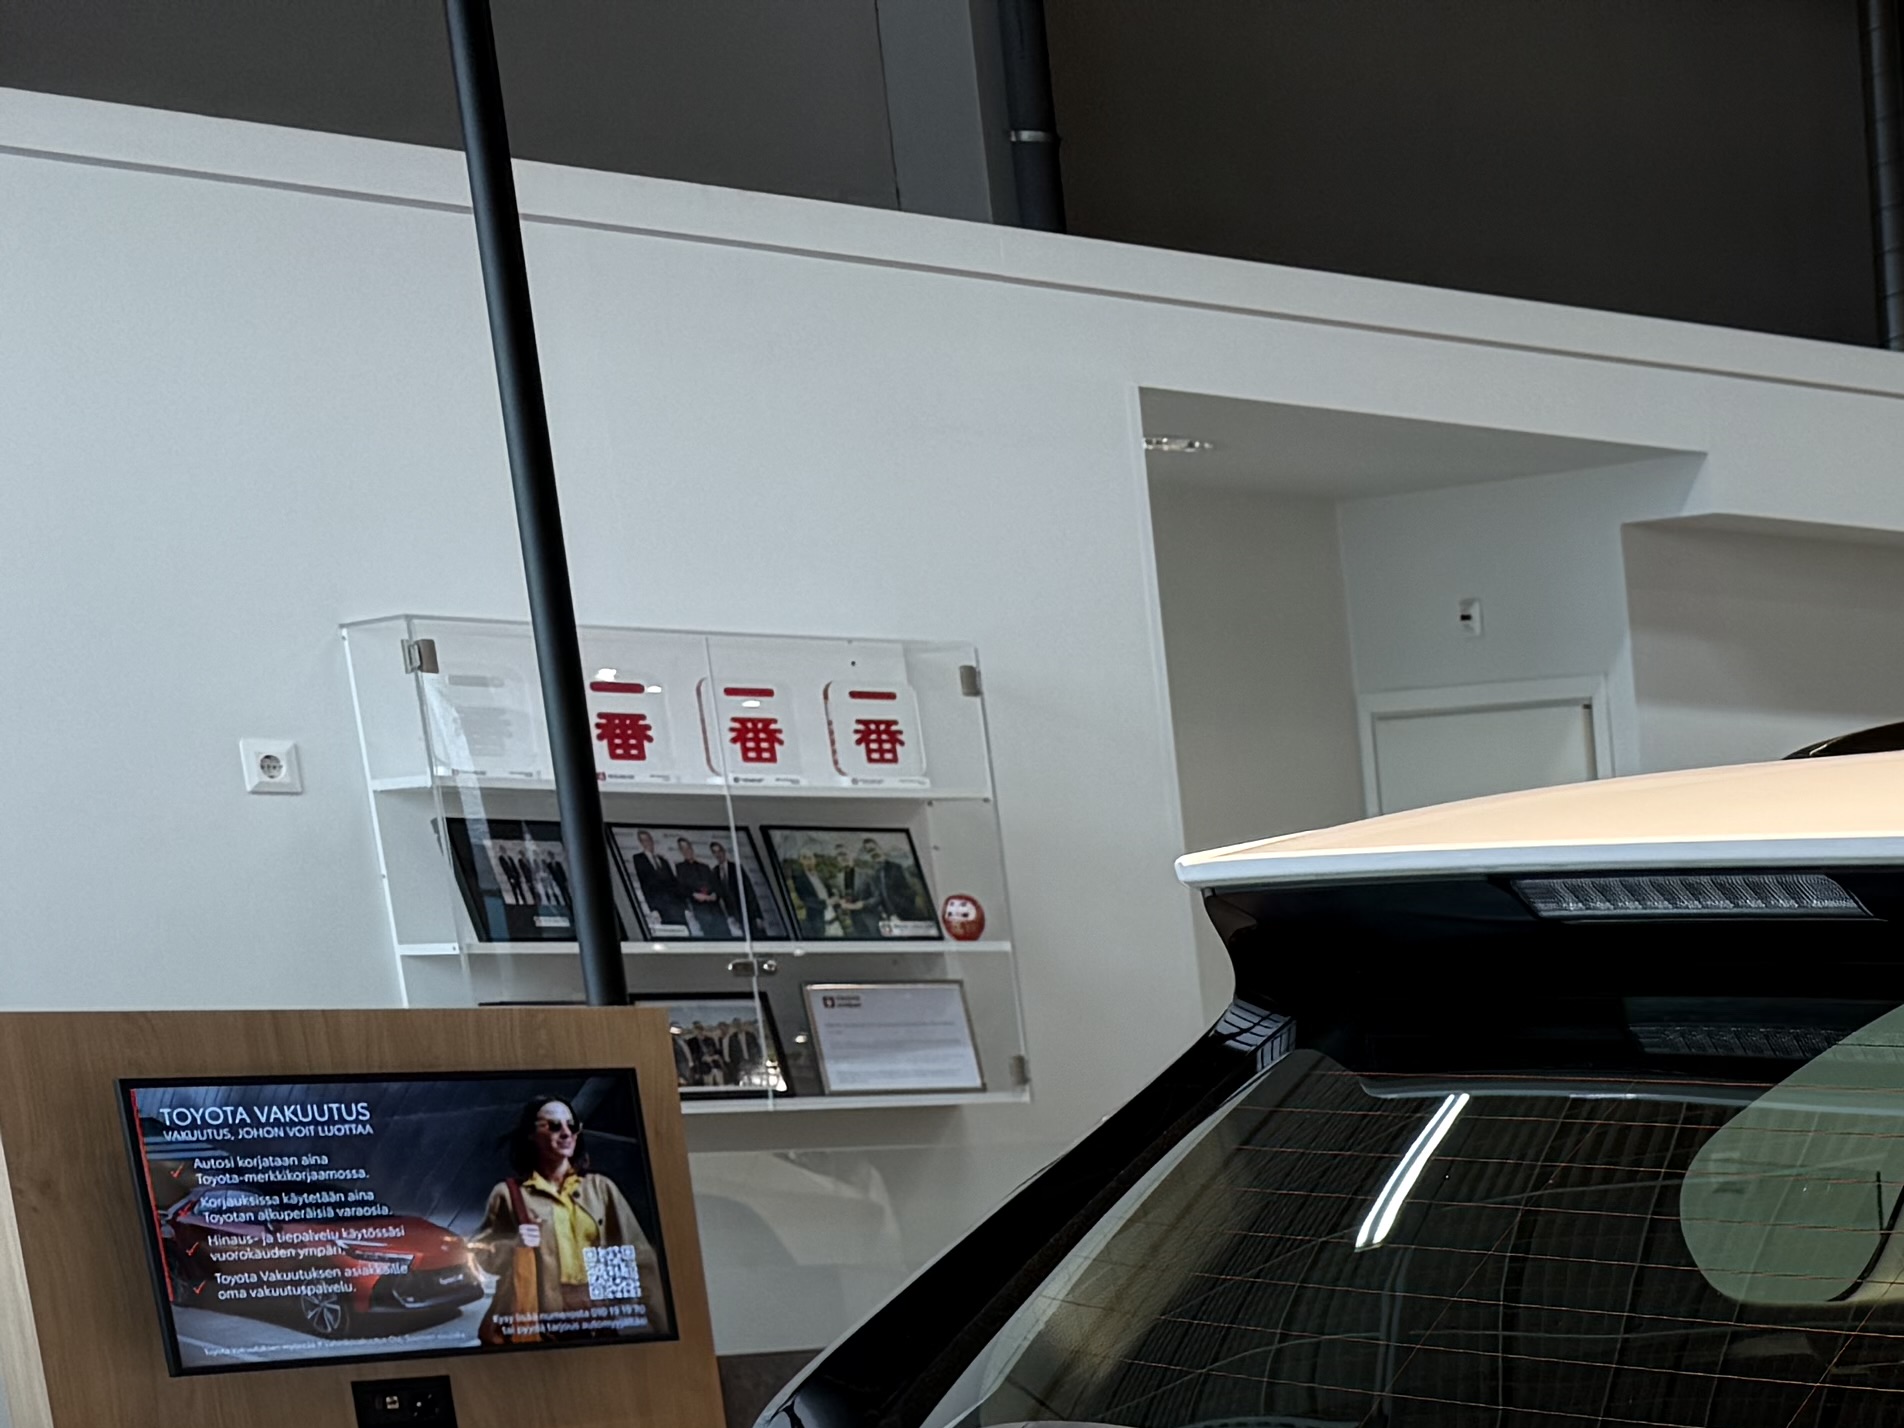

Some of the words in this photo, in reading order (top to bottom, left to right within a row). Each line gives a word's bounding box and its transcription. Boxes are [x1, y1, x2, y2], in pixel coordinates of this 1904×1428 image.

[159, 1105, 250, 1126] TOYOTA
[253, 1102, 371, 1122] VAKUUTUS
[163, 1128, 235, 1141] VAKUUTUS,
[238, 1126, 284, 1139] JOHON
[286, 1125, 315, 1138] VOIT
[317, 1123, 374, 1136] LUOTTAA
[193, 1157, 234, 1169] Autosi
[237, 1155, 298, 1170] korjataan
[301, 1153, 329, 1166] aina
[200, 1193, 280, 1209] Korjauksissa
[282, 1191, 345, 1207] käytetään
[348, 1189, 375, 1202] aina
[203, 1211, 255, 1225] Toyotan
[208, 1233, 259, 1247] Hinaus-
[262, 1232, 274, 1247] ja
[214, 1272, 258, 1287] Toyota
[260, 1267, 342, 1284] Vakuutuksen
[218, 1289, 247, 1300] oma
